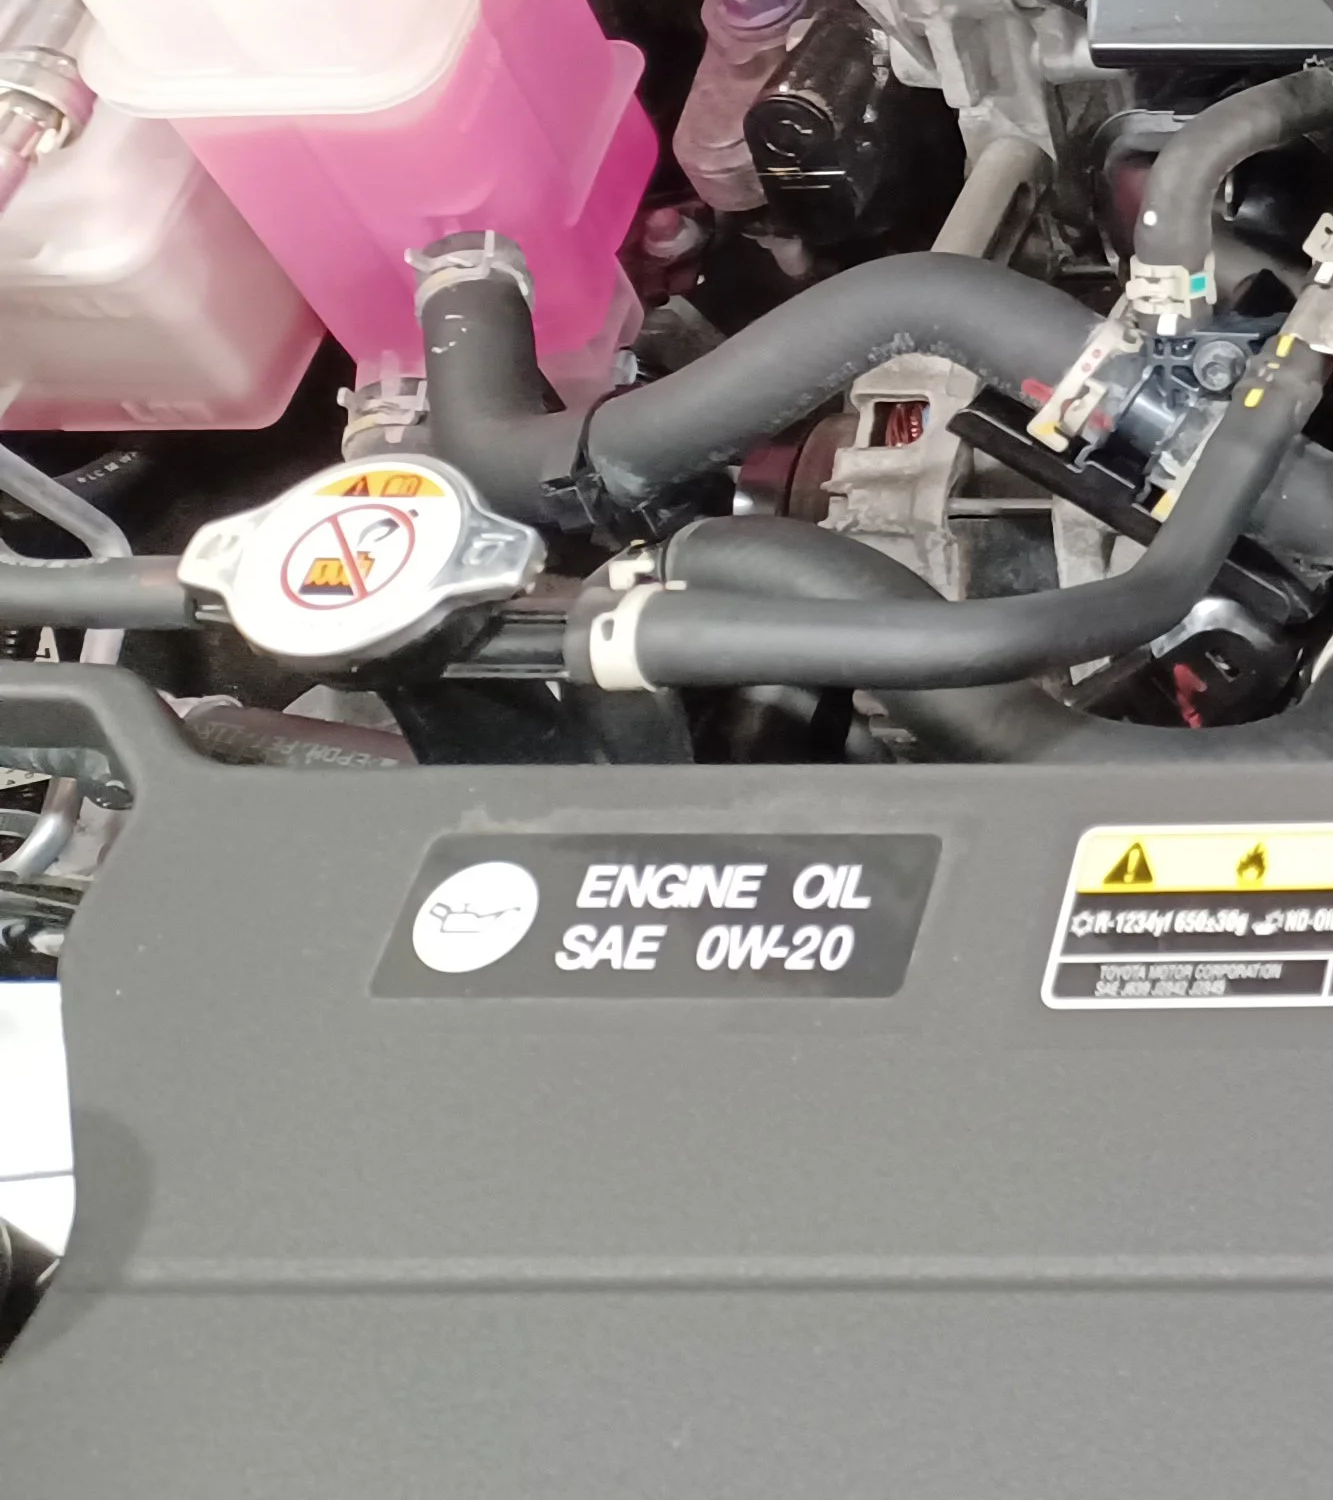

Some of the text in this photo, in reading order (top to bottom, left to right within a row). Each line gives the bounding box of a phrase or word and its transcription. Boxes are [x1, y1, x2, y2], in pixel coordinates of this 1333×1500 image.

[576, 862, 872, 910] ENGINE OIL
[554, 924, 855, 972] SAE 0W-20
[1100, 962, 1283, 980] TOYOTA MOTOR CORPORATION
